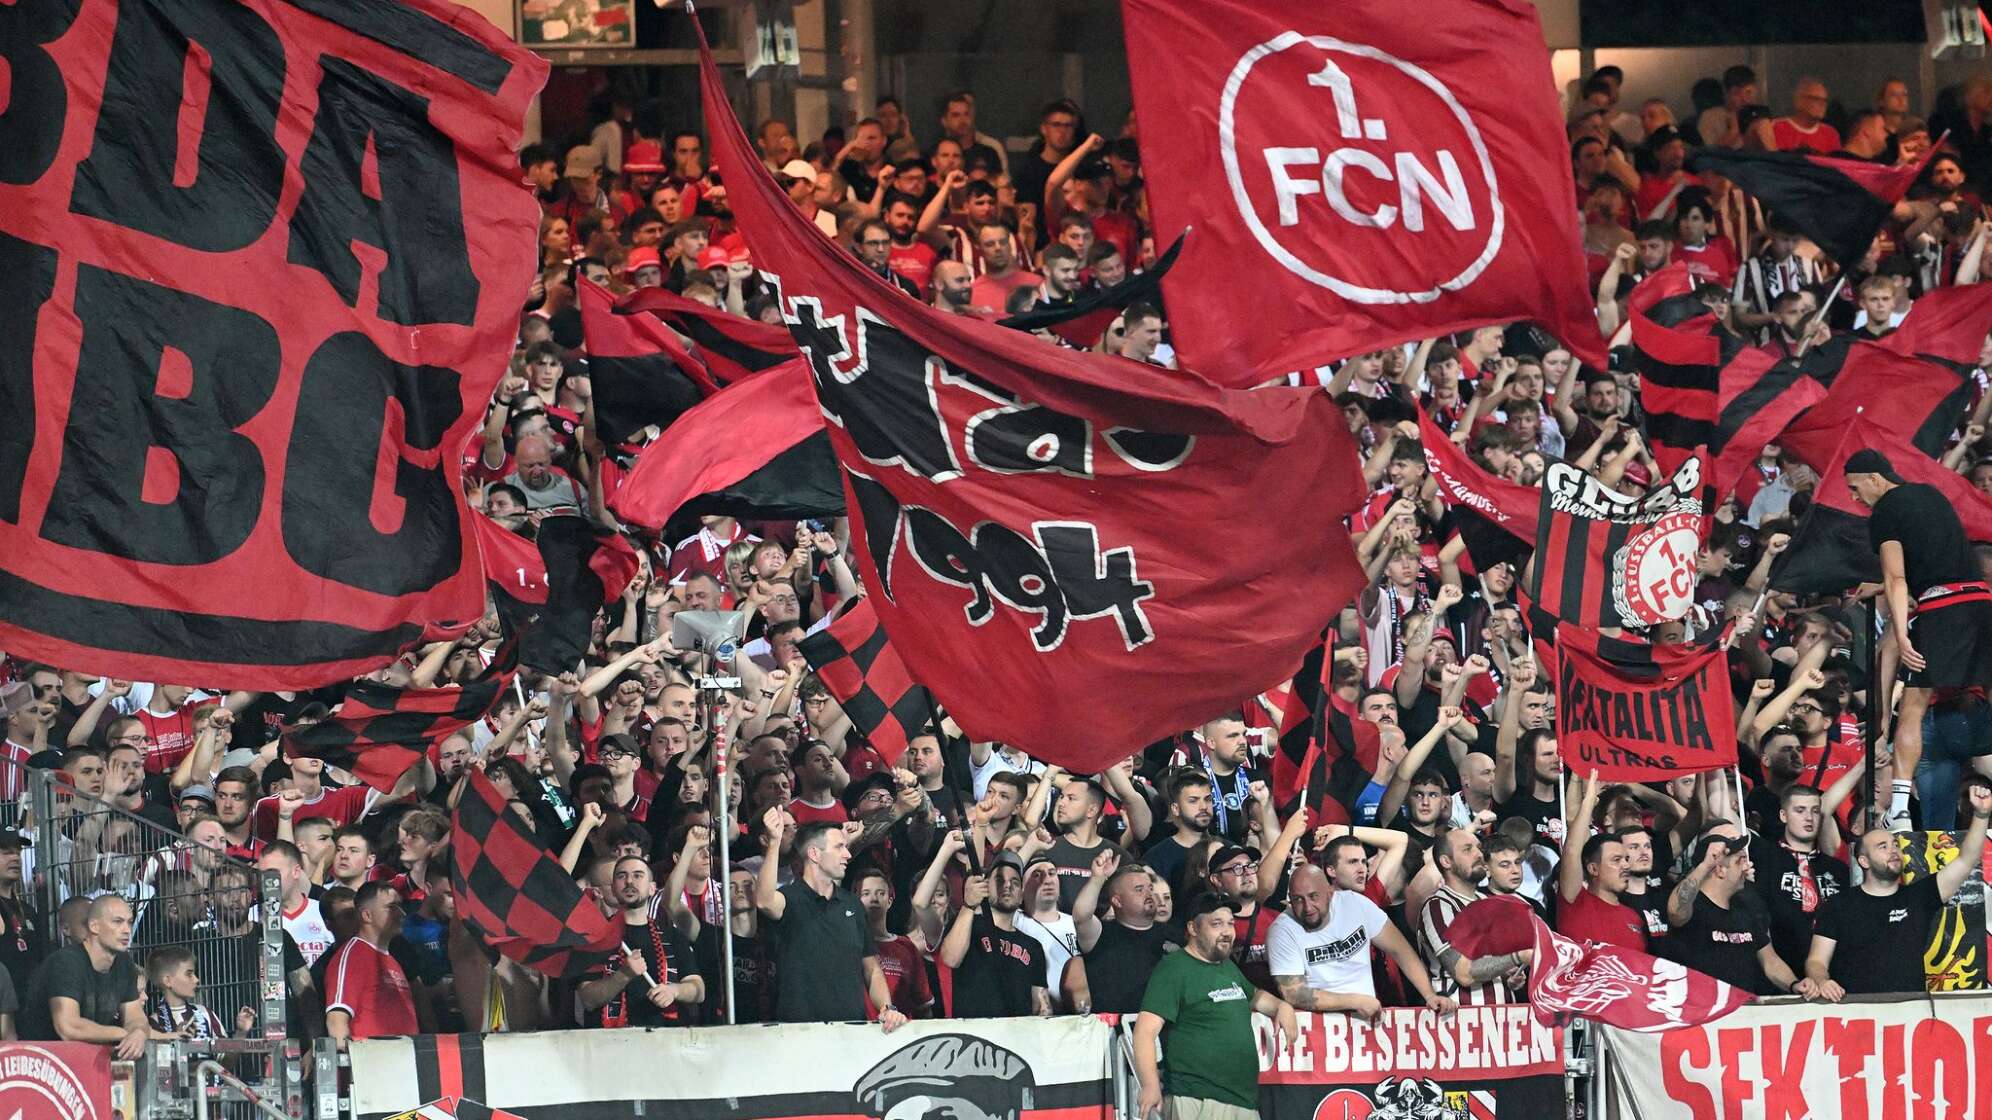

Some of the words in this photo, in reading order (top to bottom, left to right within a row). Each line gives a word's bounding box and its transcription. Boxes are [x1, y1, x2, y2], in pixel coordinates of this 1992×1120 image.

[1306, 58, 1388, 141] 1.
[1262, 146, 1477, 233] FCN
[1579, 743, 1678, 769] ULTRAS
[1250, 1009, 1314, 1073] DIE
[1323, 1006, 1557, 1073] BESESSENEN
